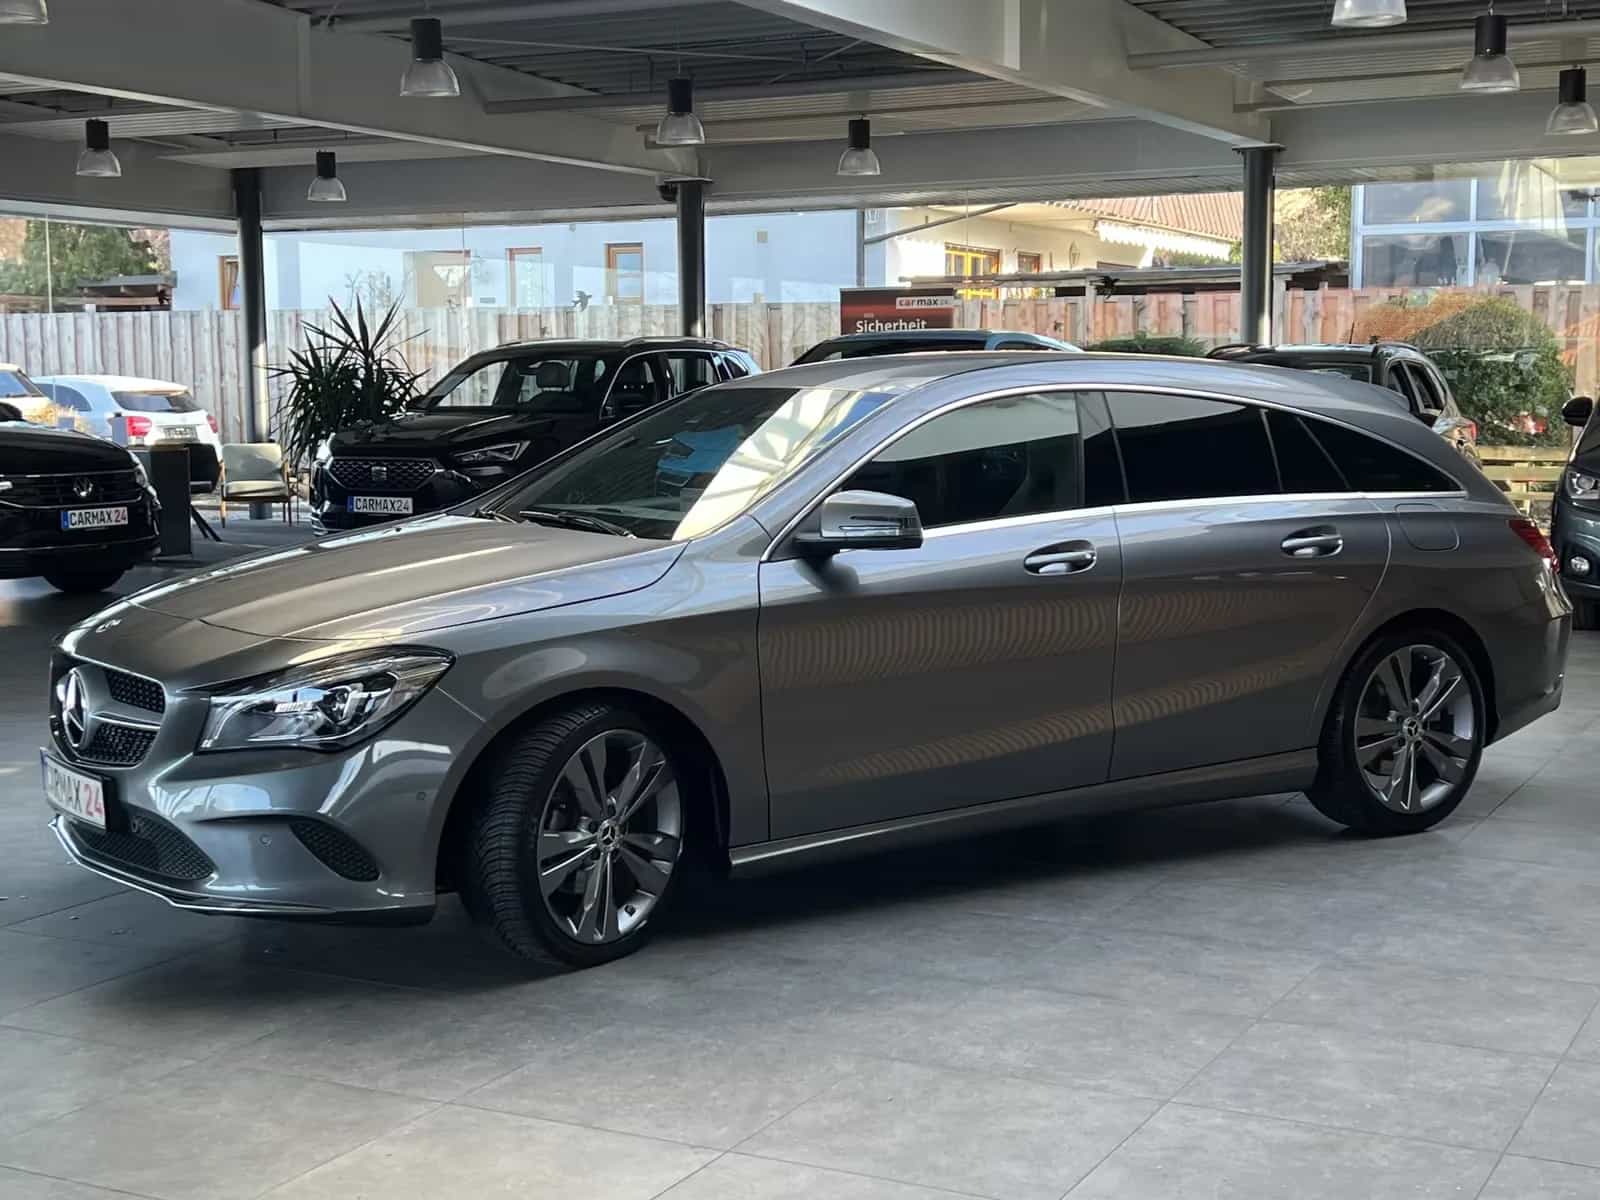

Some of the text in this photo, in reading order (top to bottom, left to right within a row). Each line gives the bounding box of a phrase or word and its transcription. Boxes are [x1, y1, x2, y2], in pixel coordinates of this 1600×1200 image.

[856, 318, 927, 333] Sicherheit
[70, 510, 113, 526] CARMAX
[84, 783, 103, 817] 24
